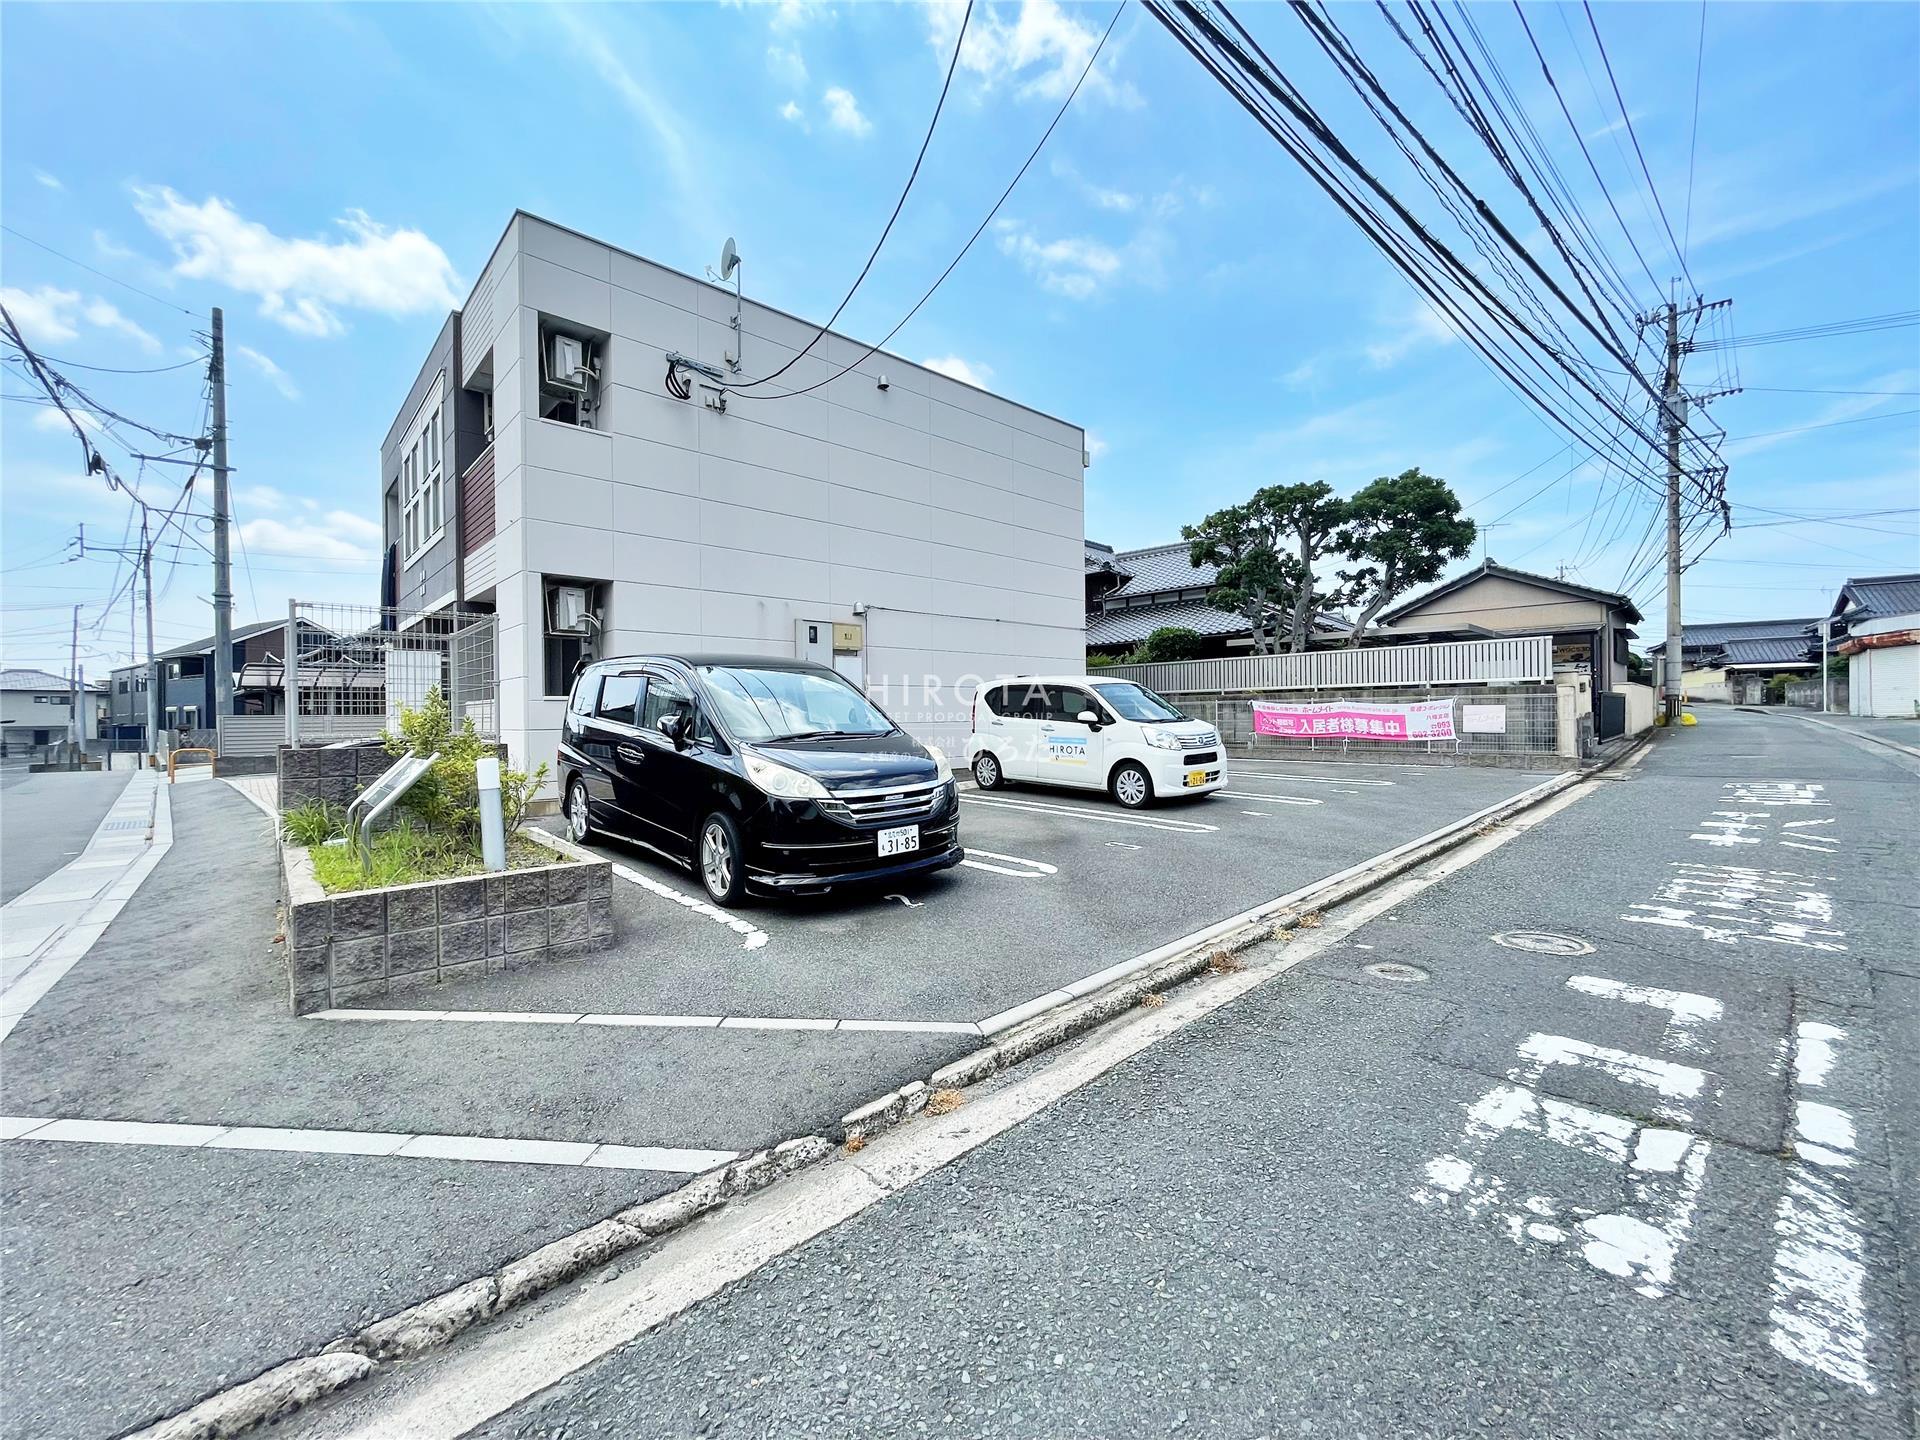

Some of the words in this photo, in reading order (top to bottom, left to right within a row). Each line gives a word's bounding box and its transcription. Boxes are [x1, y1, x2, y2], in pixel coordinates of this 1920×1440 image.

[1302, 704, 1334, 714] ホームメイト
[1299, 717, 1400, 736] 入居者様募集中
[1049, 745, 1086, 755] HIROTA
[887, 836, 917, 853] 31-85
